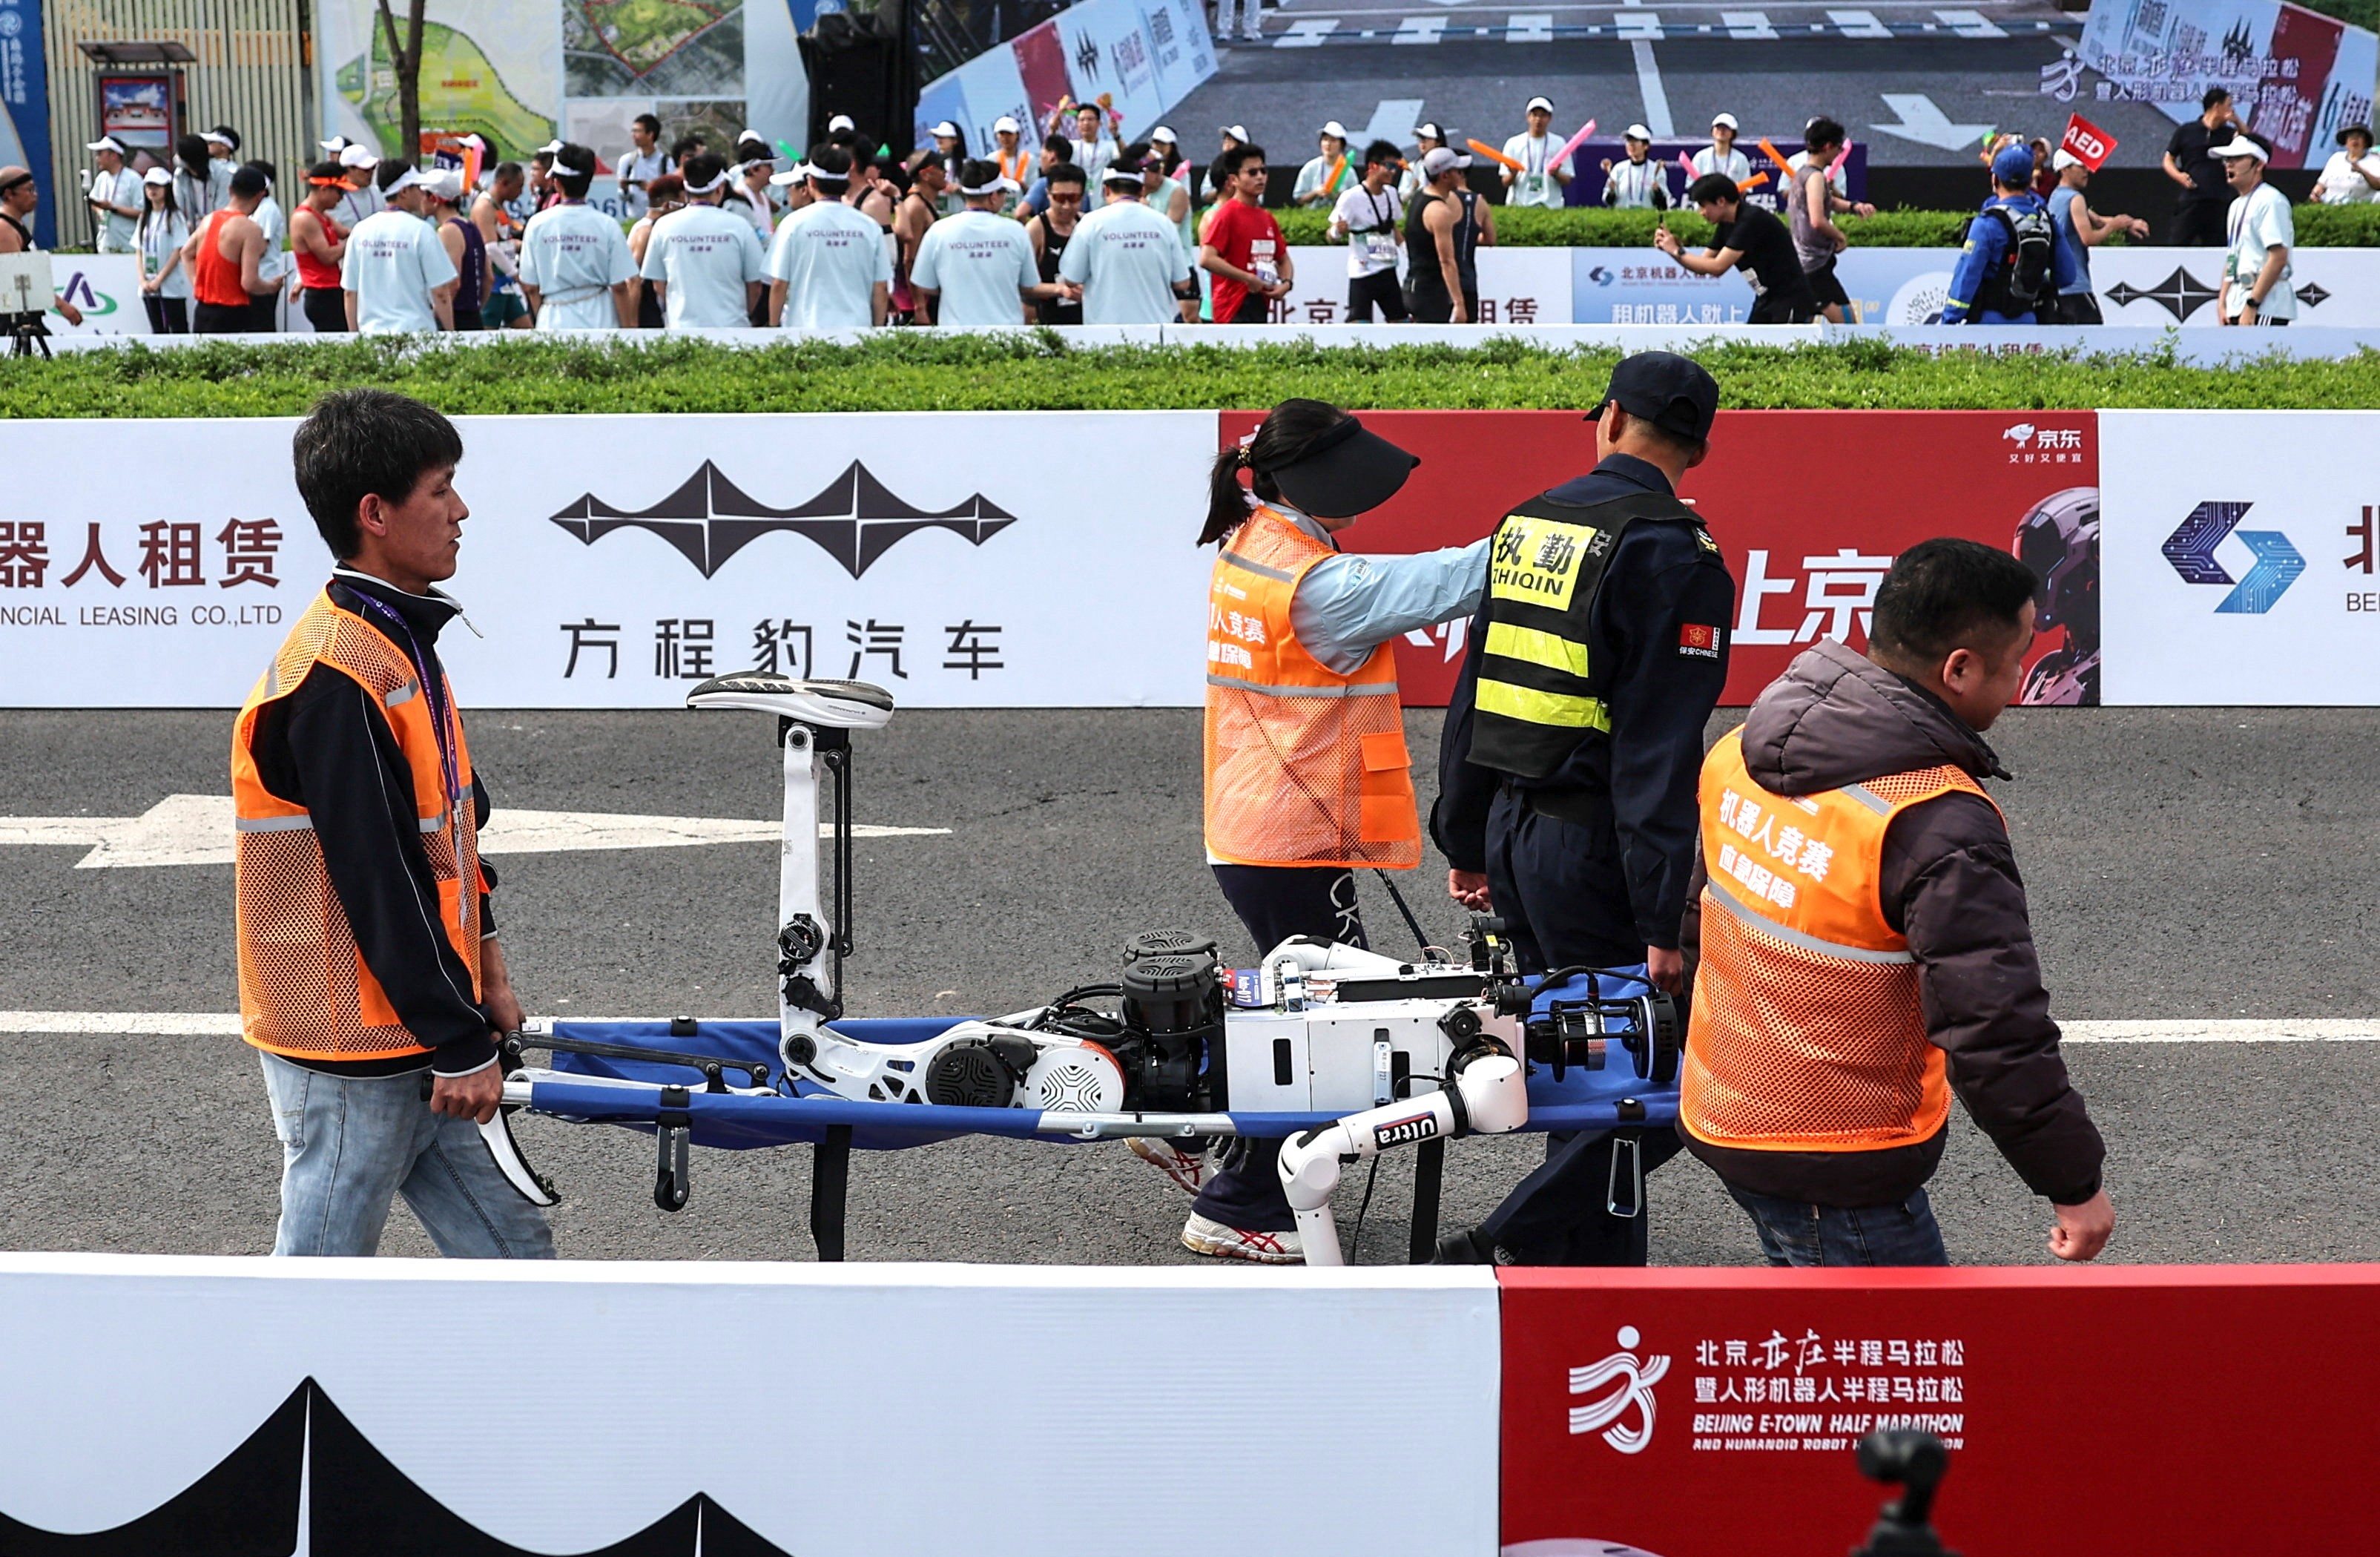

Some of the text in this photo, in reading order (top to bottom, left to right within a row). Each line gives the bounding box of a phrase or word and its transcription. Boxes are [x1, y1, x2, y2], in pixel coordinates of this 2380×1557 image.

[2095, 82, 2298, 103] 暨人形机器人程马拉松
[2066, 125, 2104, 159] AED
[543, 234, 598, 243] VOLUNTEER
[670, 235, 731, 243] VOLUNTEER
[806, 229, 864, 238] VOLUNTEER
[1103, 231, 1160, 241] VOLUNTEER
[949, 240, 1009, 249] VOLUNTEER
[1621, 266, 1721, 279] 北京机器人
[2037, 429, 2081, 449] 京东
[2008, 453, 2081, 464] 又好又便宜
[1496, 527, 1575, 575] 执勤
[1493, 568, 1564, 596] ZHIQIN
[2347, 593, 2380, 612] BE
[80, 606, 177, 625] LEASING
[191, 605, 282, 628] CO.,LTD
[1210, 602, 1265, 645] 人竞赛
[560, 617, 1004, 680] 方程豹汽车
[1719, 788, 1833, 883] 机器人竞赛
[1718, 843, 1796, 909] 应急保障
[1378, 1119, 1435, 1144] Ultra
[1695, 1328, 1964, 1376] 北京亦庄半程马拉松
[1695, 1376, 1964, 1403] 暨人形机器人半程马拉松
[1692, 1414, 1964, 1433] BEIJING E-TOWN HALF MARATHON
[1693, 1438, 1722, 1450] AND
[1725, 1438, 1799, 1450] HUMANOID
[1803, 1438, 1848, 1450] ROBOT
